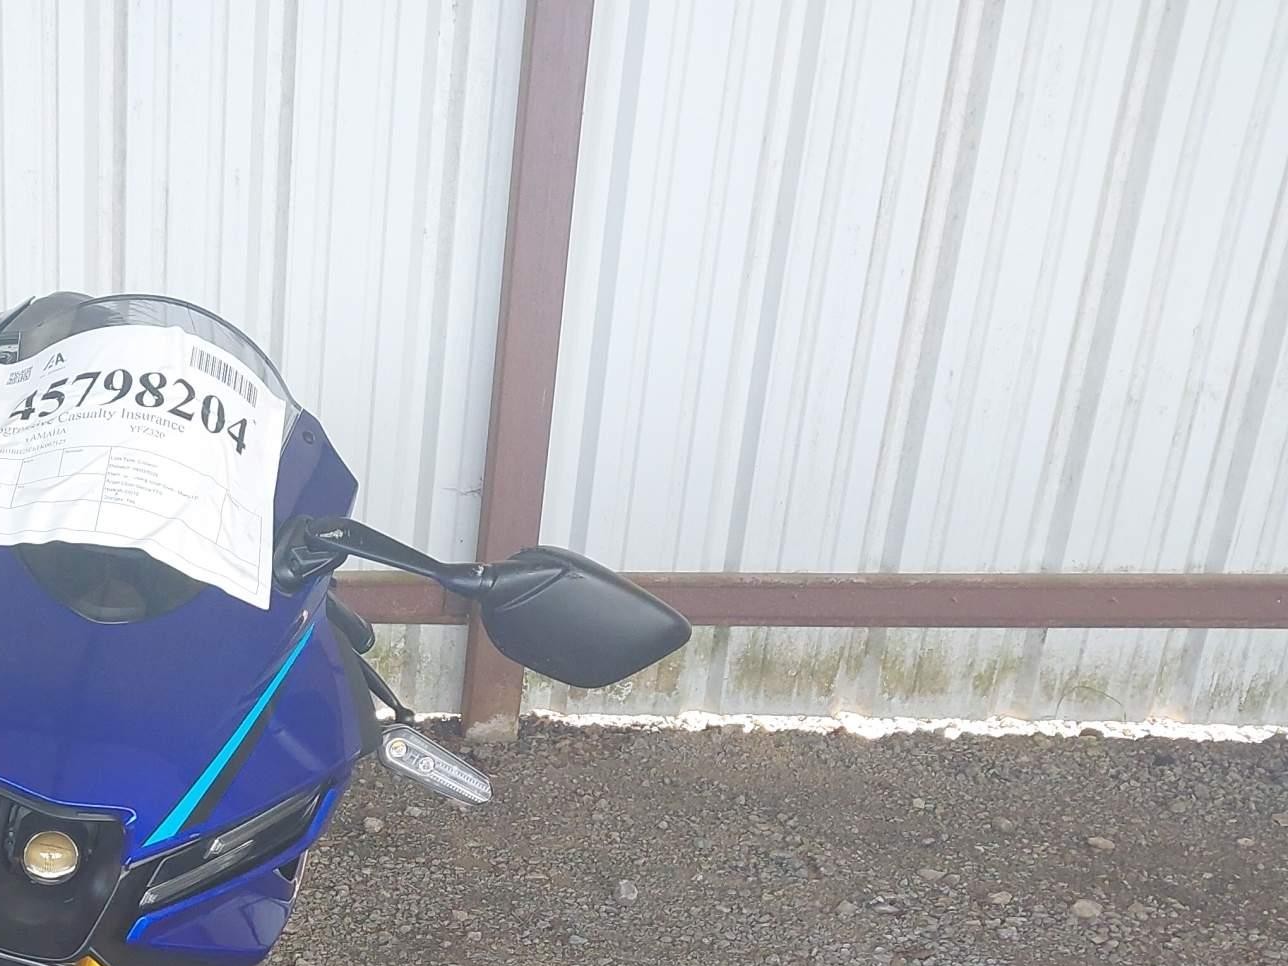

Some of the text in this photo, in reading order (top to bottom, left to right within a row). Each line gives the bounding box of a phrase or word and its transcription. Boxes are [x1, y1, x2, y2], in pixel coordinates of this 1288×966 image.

[8, 368, 247, 455] 45798204
[58, 407, 116, 422] Casualty
[121, 407, 185, 433] Insurance
